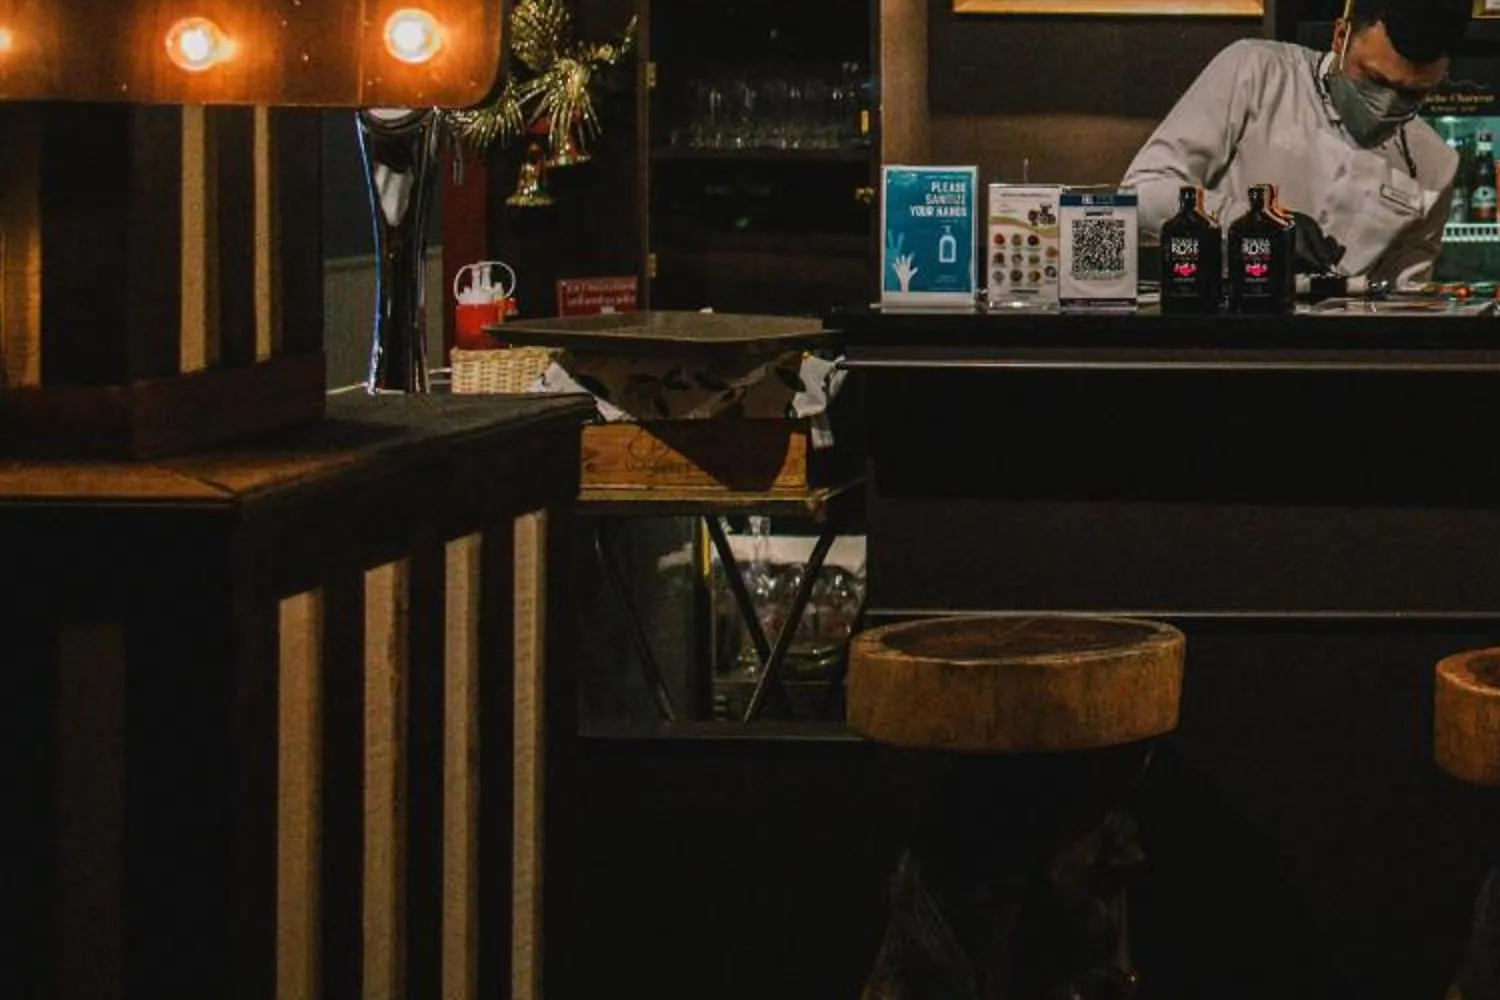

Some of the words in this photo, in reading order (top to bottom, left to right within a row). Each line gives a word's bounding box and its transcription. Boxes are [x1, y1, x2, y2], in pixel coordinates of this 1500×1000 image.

[931, 181, 967, 193] PLEASE
[909, 205, 935, 217] YOUR
[936, 205, 967, 217] HANDS
